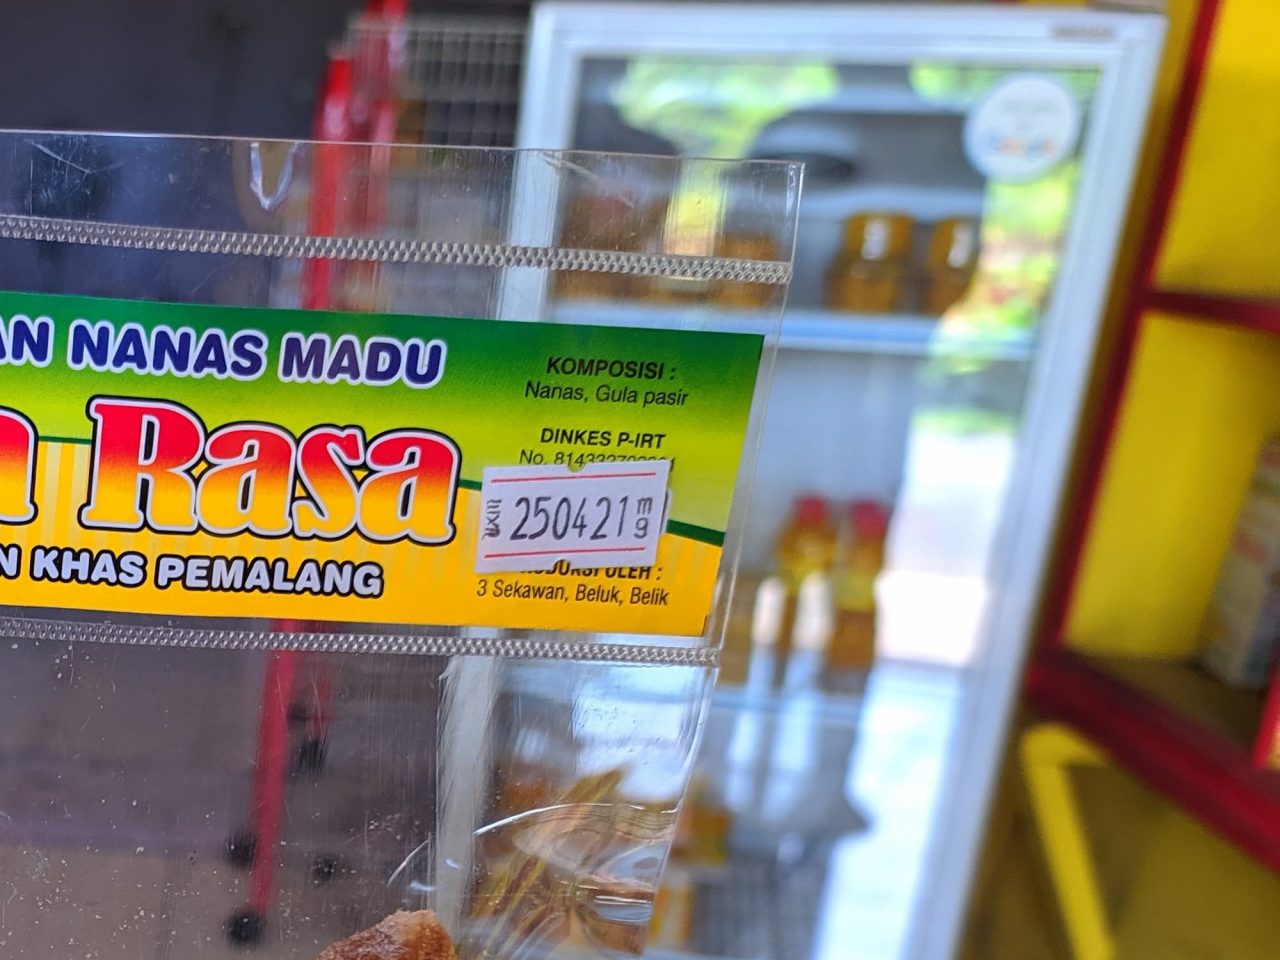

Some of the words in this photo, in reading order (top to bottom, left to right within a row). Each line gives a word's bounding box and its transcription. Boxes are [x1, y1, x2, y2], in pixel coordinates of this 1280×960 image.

[68, 319, 268, 381] NANAS
[279, 332, 448, 390] MADU
[546, 356, 665, 380] KOMPOSISI
[524, 380, 588, 403] Nanas,
[595, 384, 638, 404] Gula
[642, 388, 689, 408] pasir
[540, 427, 612, 446] DINKES
[616, 431, 666, 449] P-IRT
[78, 394, 462, 546] Rasa
[509, 495, 629, 541] 250421
[30, 545, 148, 587] KHAS
[154, 553, 384, 599] PEMALANG
[476, 579, 488, 597] 3
[492, 579, 569, 603] Sekawan,
[575, 584, 624, 606] Beluk,
[629, 587, 670, 606] Belik
